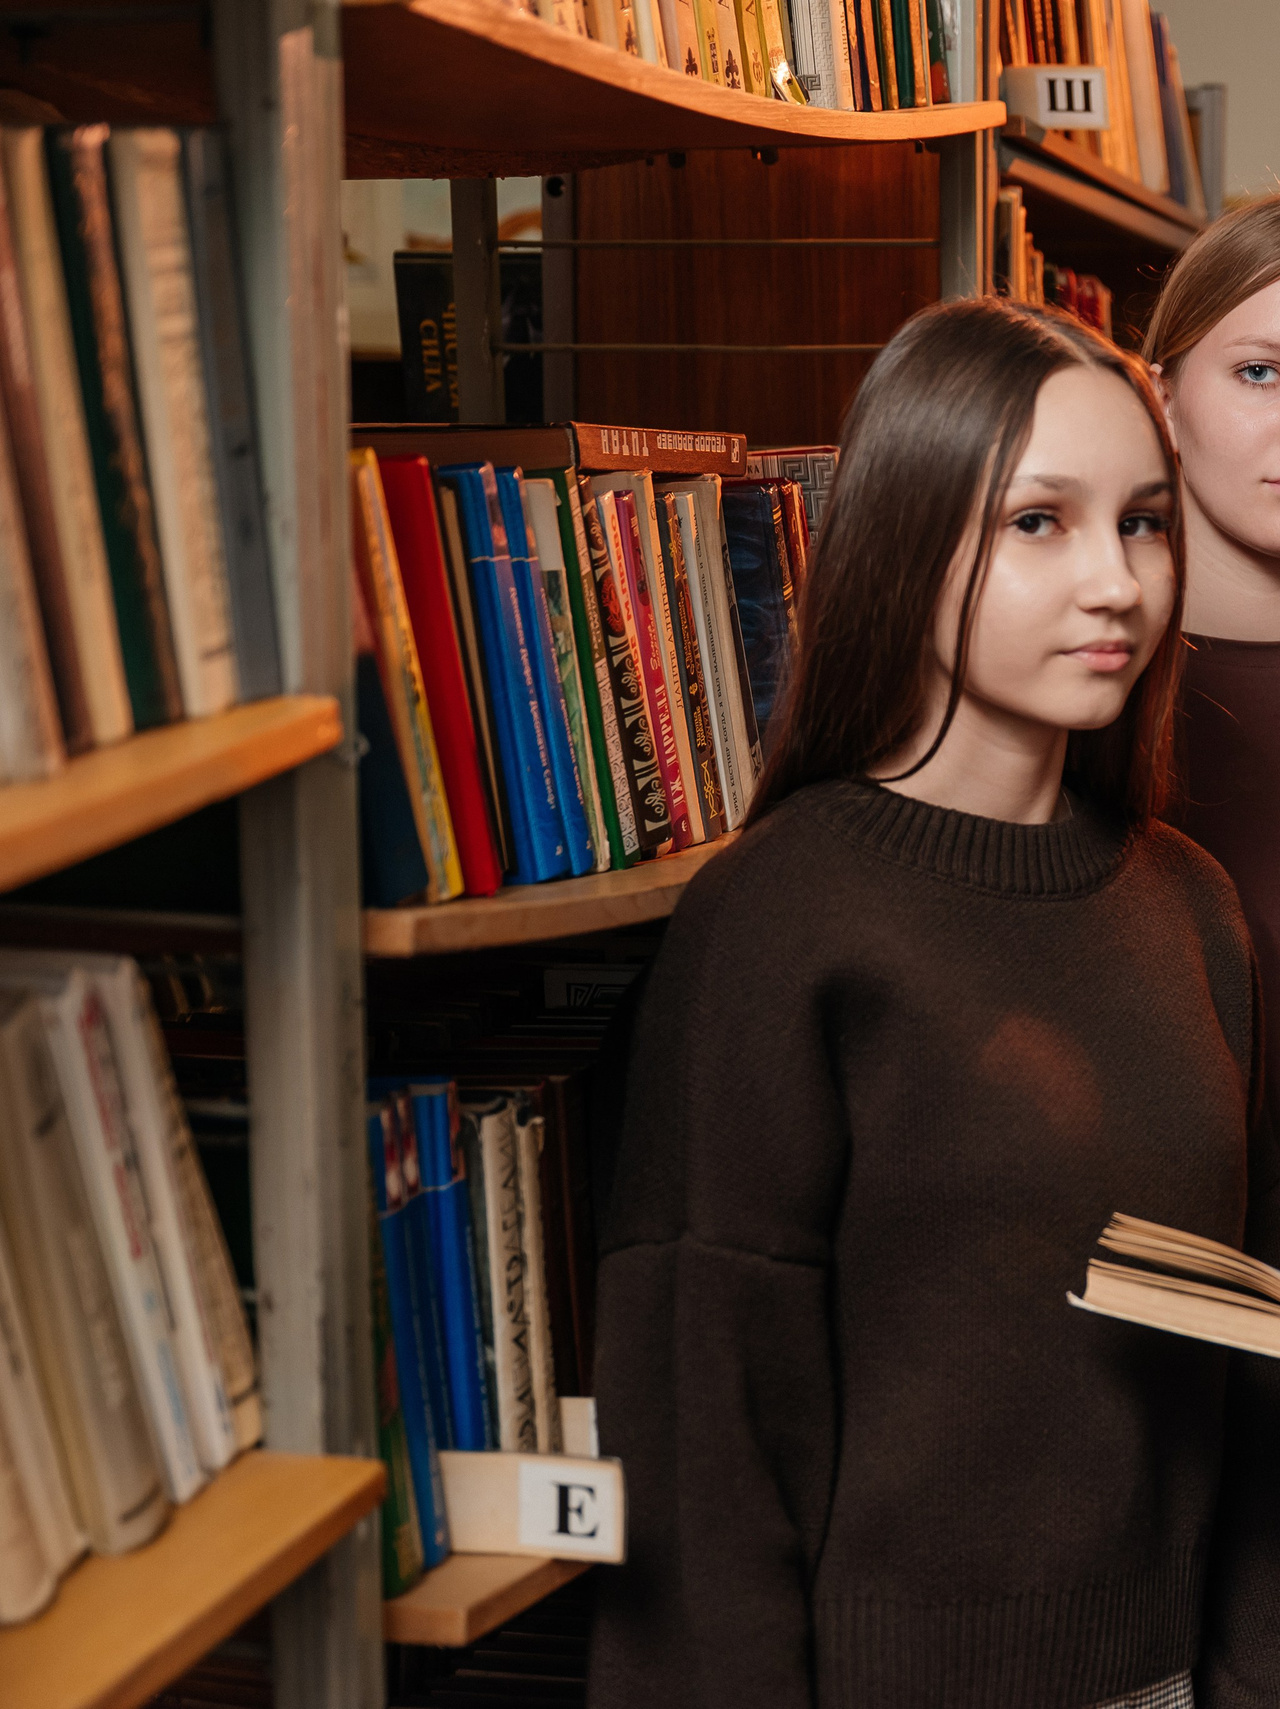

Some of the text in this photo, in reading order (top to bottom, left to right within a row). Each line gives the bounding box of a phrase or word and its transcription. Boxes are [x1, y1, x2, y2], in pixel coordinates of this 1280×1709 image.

[419, 319, 440, 392] СИЛА
[600, 428, 649, 457] ТИТАН
[657, 553, 684, 709] ДАНТЕ АЛИГЬЕРИ
[654, 683, 680, 768] ДАРРЕЛЛ
[720, 711, 729, 743] КОГДА
